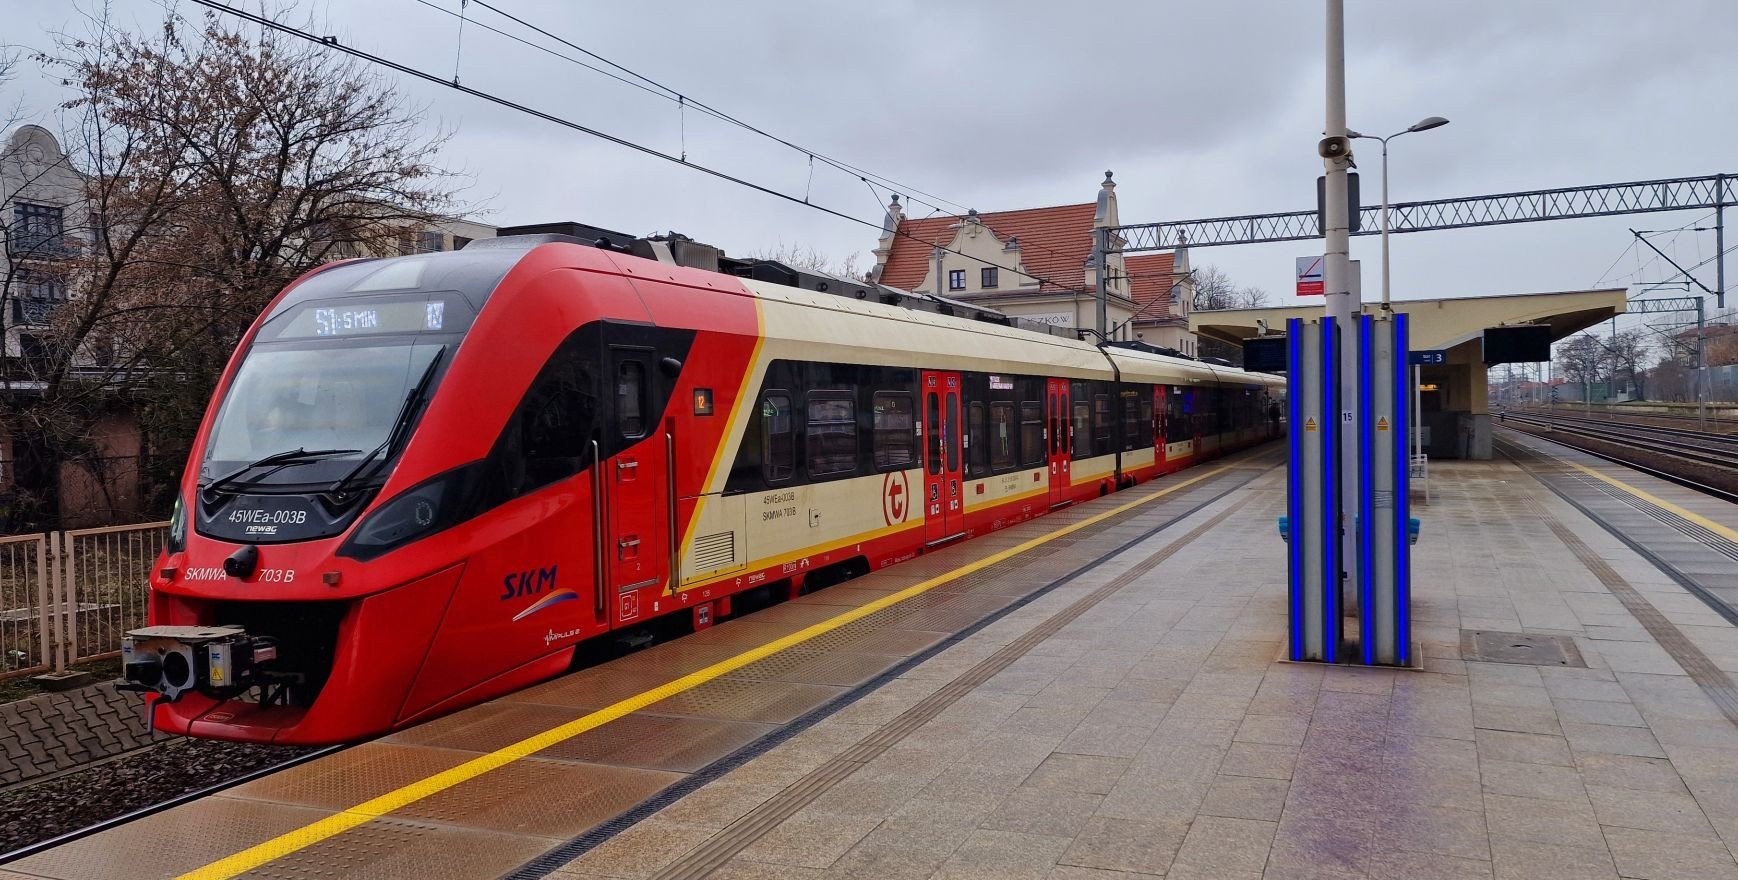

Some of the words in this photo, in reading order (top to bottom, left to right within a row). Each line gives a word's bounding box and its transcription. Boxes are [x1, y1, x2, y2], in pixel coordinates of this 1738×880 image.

[344, 312, 351, 328] 5
[354, 310, 377, 328] MIN
[1435, 353, 1443, 362] 3
[698, 395, 705, 408] 12
[1343, 412, 1353, 421] 15
[763, 491, 795, 505] 45WEa-003B
[228, 510, 307, 524] 45WEa-003B
[762, 510, 783, 521] SKMWA
[246, 525, 278, 533] newag
[184, 567, 228, 581] SKMWA
[258, 569, 282, 582] 703
[284, 570, 295, 583] B
[501, 564, 557, 600] SKM
